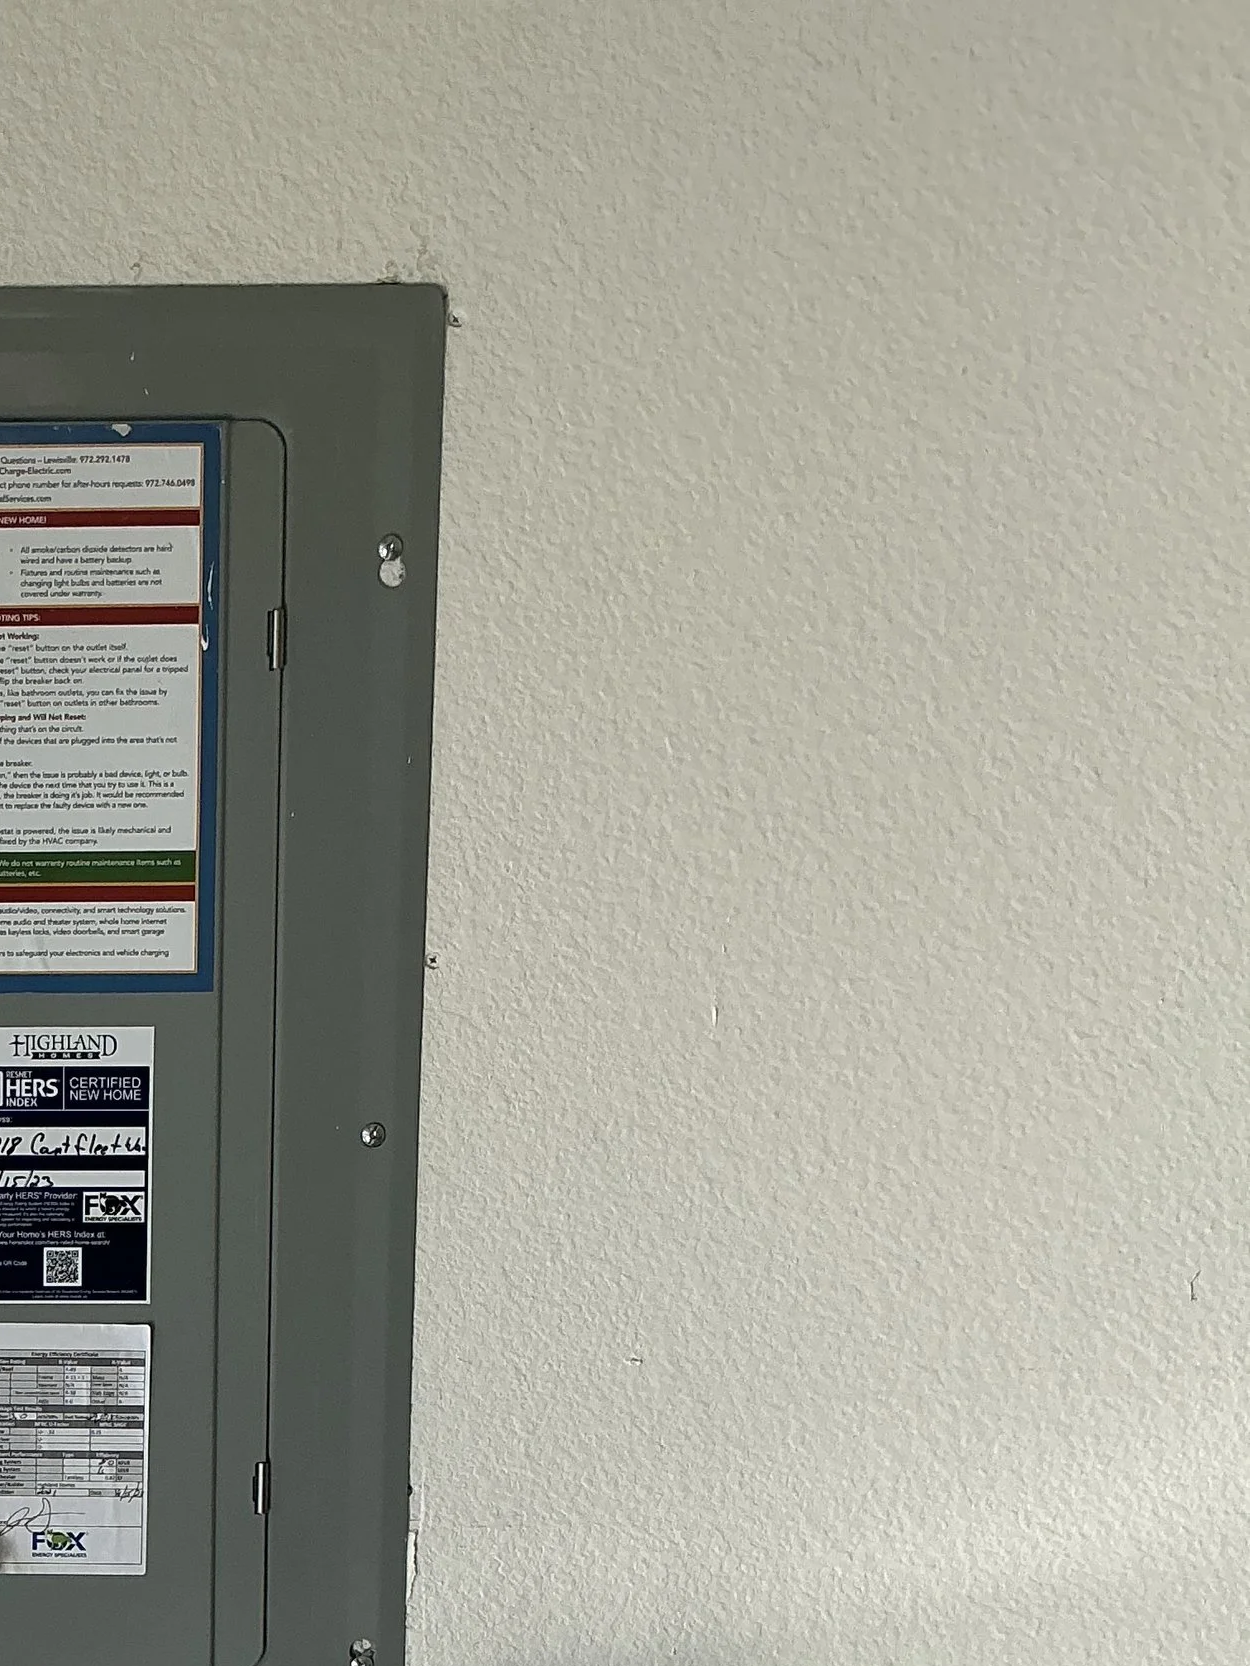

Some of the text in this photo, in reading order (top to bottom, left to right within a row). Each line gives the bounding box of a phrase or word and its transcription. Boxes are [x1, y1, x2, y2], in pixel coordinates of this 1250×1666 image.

[0, 456, 36, 464] Questions
[79, 454, 130, 463] 972.292.1478
[7, 480, 30, 490] phone
[32, 480, 60, 488] number
[60, 479, 71, 488] for
[72, 479, 110, 488] after-hours
[111, 480, 143, 488] requests:
[144, 478, 195, 487] 972.746.0498
[18, 515, 47, 524] HOME!
[7, 631, 39, 641] Working:
[11, 676, 23, 684] the
[24, 676, 52, 684] breaker
[53, 676, 70, 684] back
[32, 712, 46, 720] Will
[9, 1034, 118, 1057] HIGHLAND
[69, 1077, 142, 1089] CERTIFIED
[69, 1089, 142, 1100] NEW HOME
[6, 1098, 38, 1107] INDEX
[43, 1191, 78, 1199] Provider:
[16, 1230, 46, 1238] Home's
[47, 1230, 71, 1238] HERS
[73, 1230, 94, 1238] Index
[32, 1529, 86, 1551] FOX
